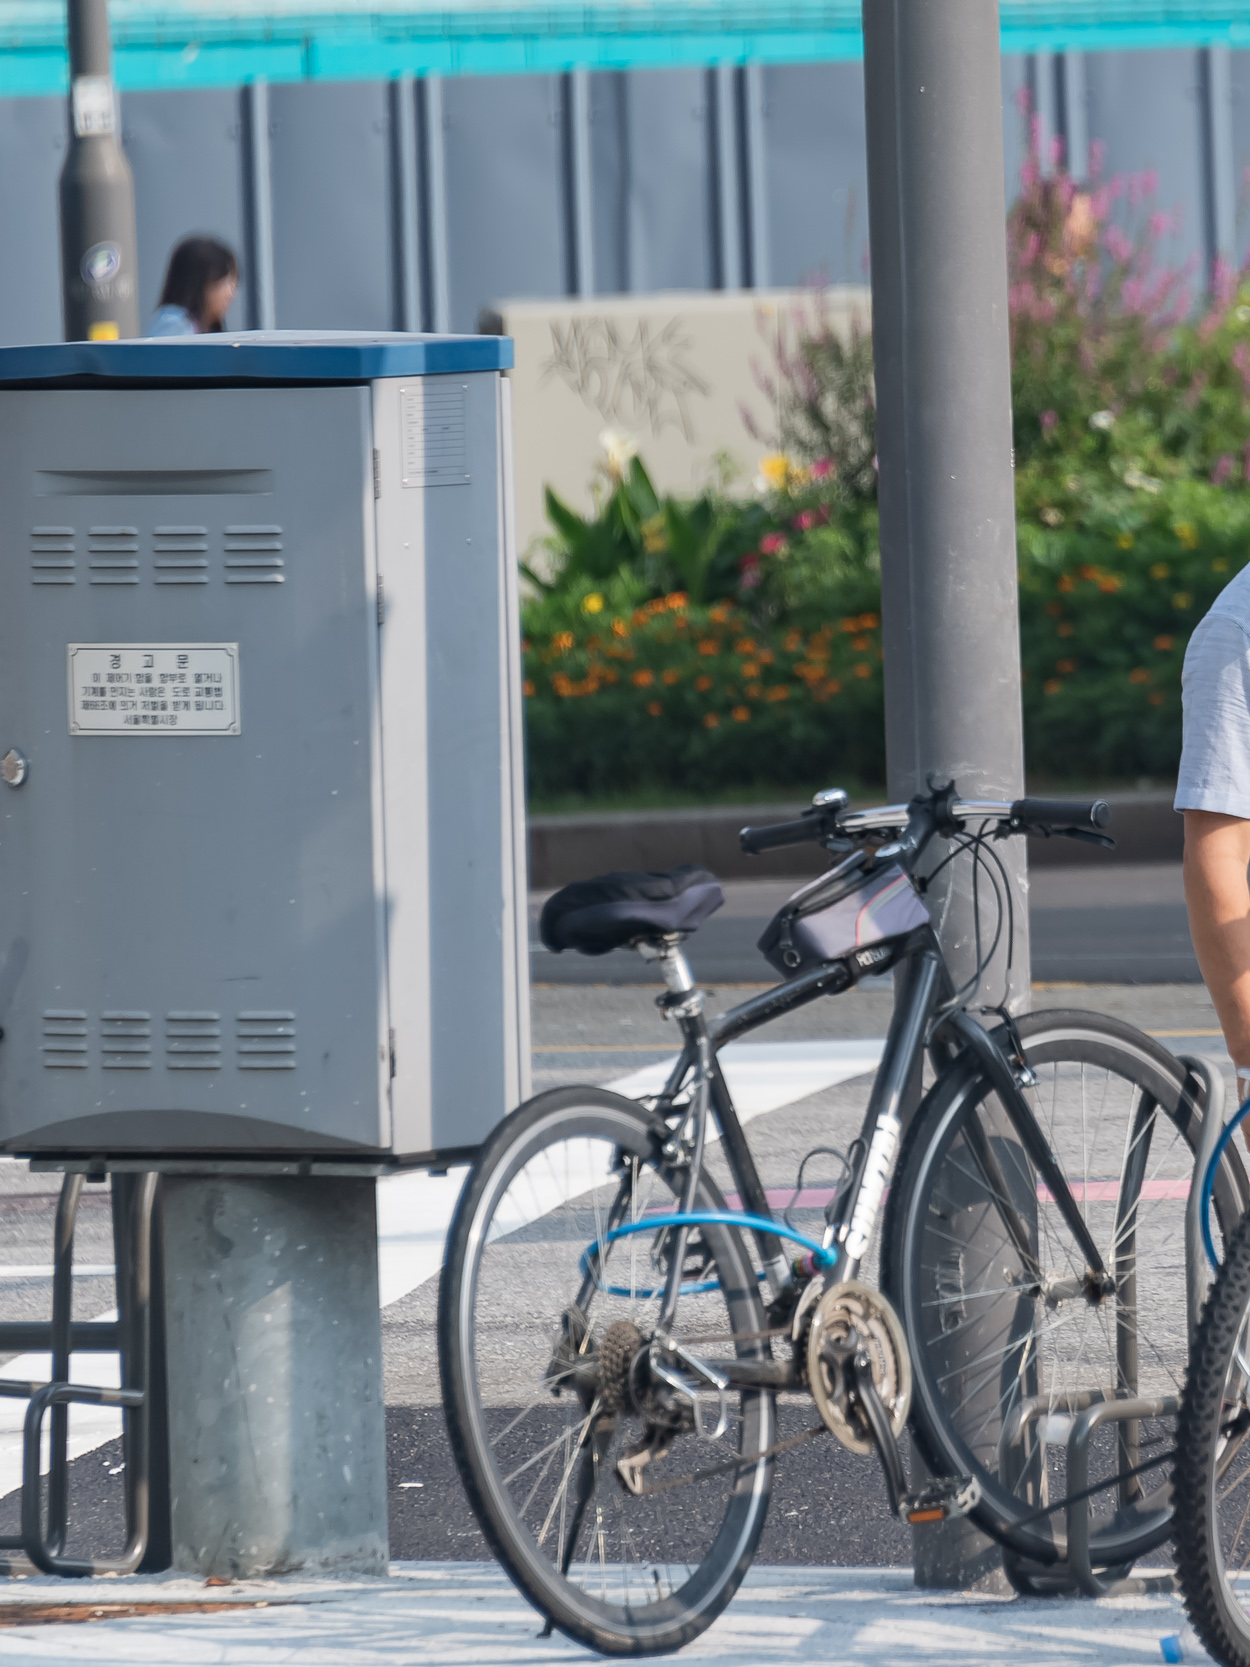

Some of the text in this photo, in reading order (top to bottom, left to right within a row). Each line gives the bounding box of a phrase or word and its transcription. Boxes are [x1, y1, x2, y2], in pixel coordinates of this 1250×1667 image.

[106, 673, 132, 684] 제어기
[159, 673, 187, 684] 함부로
[194, 673, 223, 684] 열거나
[81, 686, 107, 698] 기계를
[110, 687, 136, 698] 만지는
[139, 687, 166, 698] 사람은
[194, 687, 223, 698] 교통법
[120, 700, 138, 711] 의거
[141, 700, 168, 711] 처벌을
[172, 700, 191, 711] 받게
[124, 715, 178, 726] 서울특별시장
